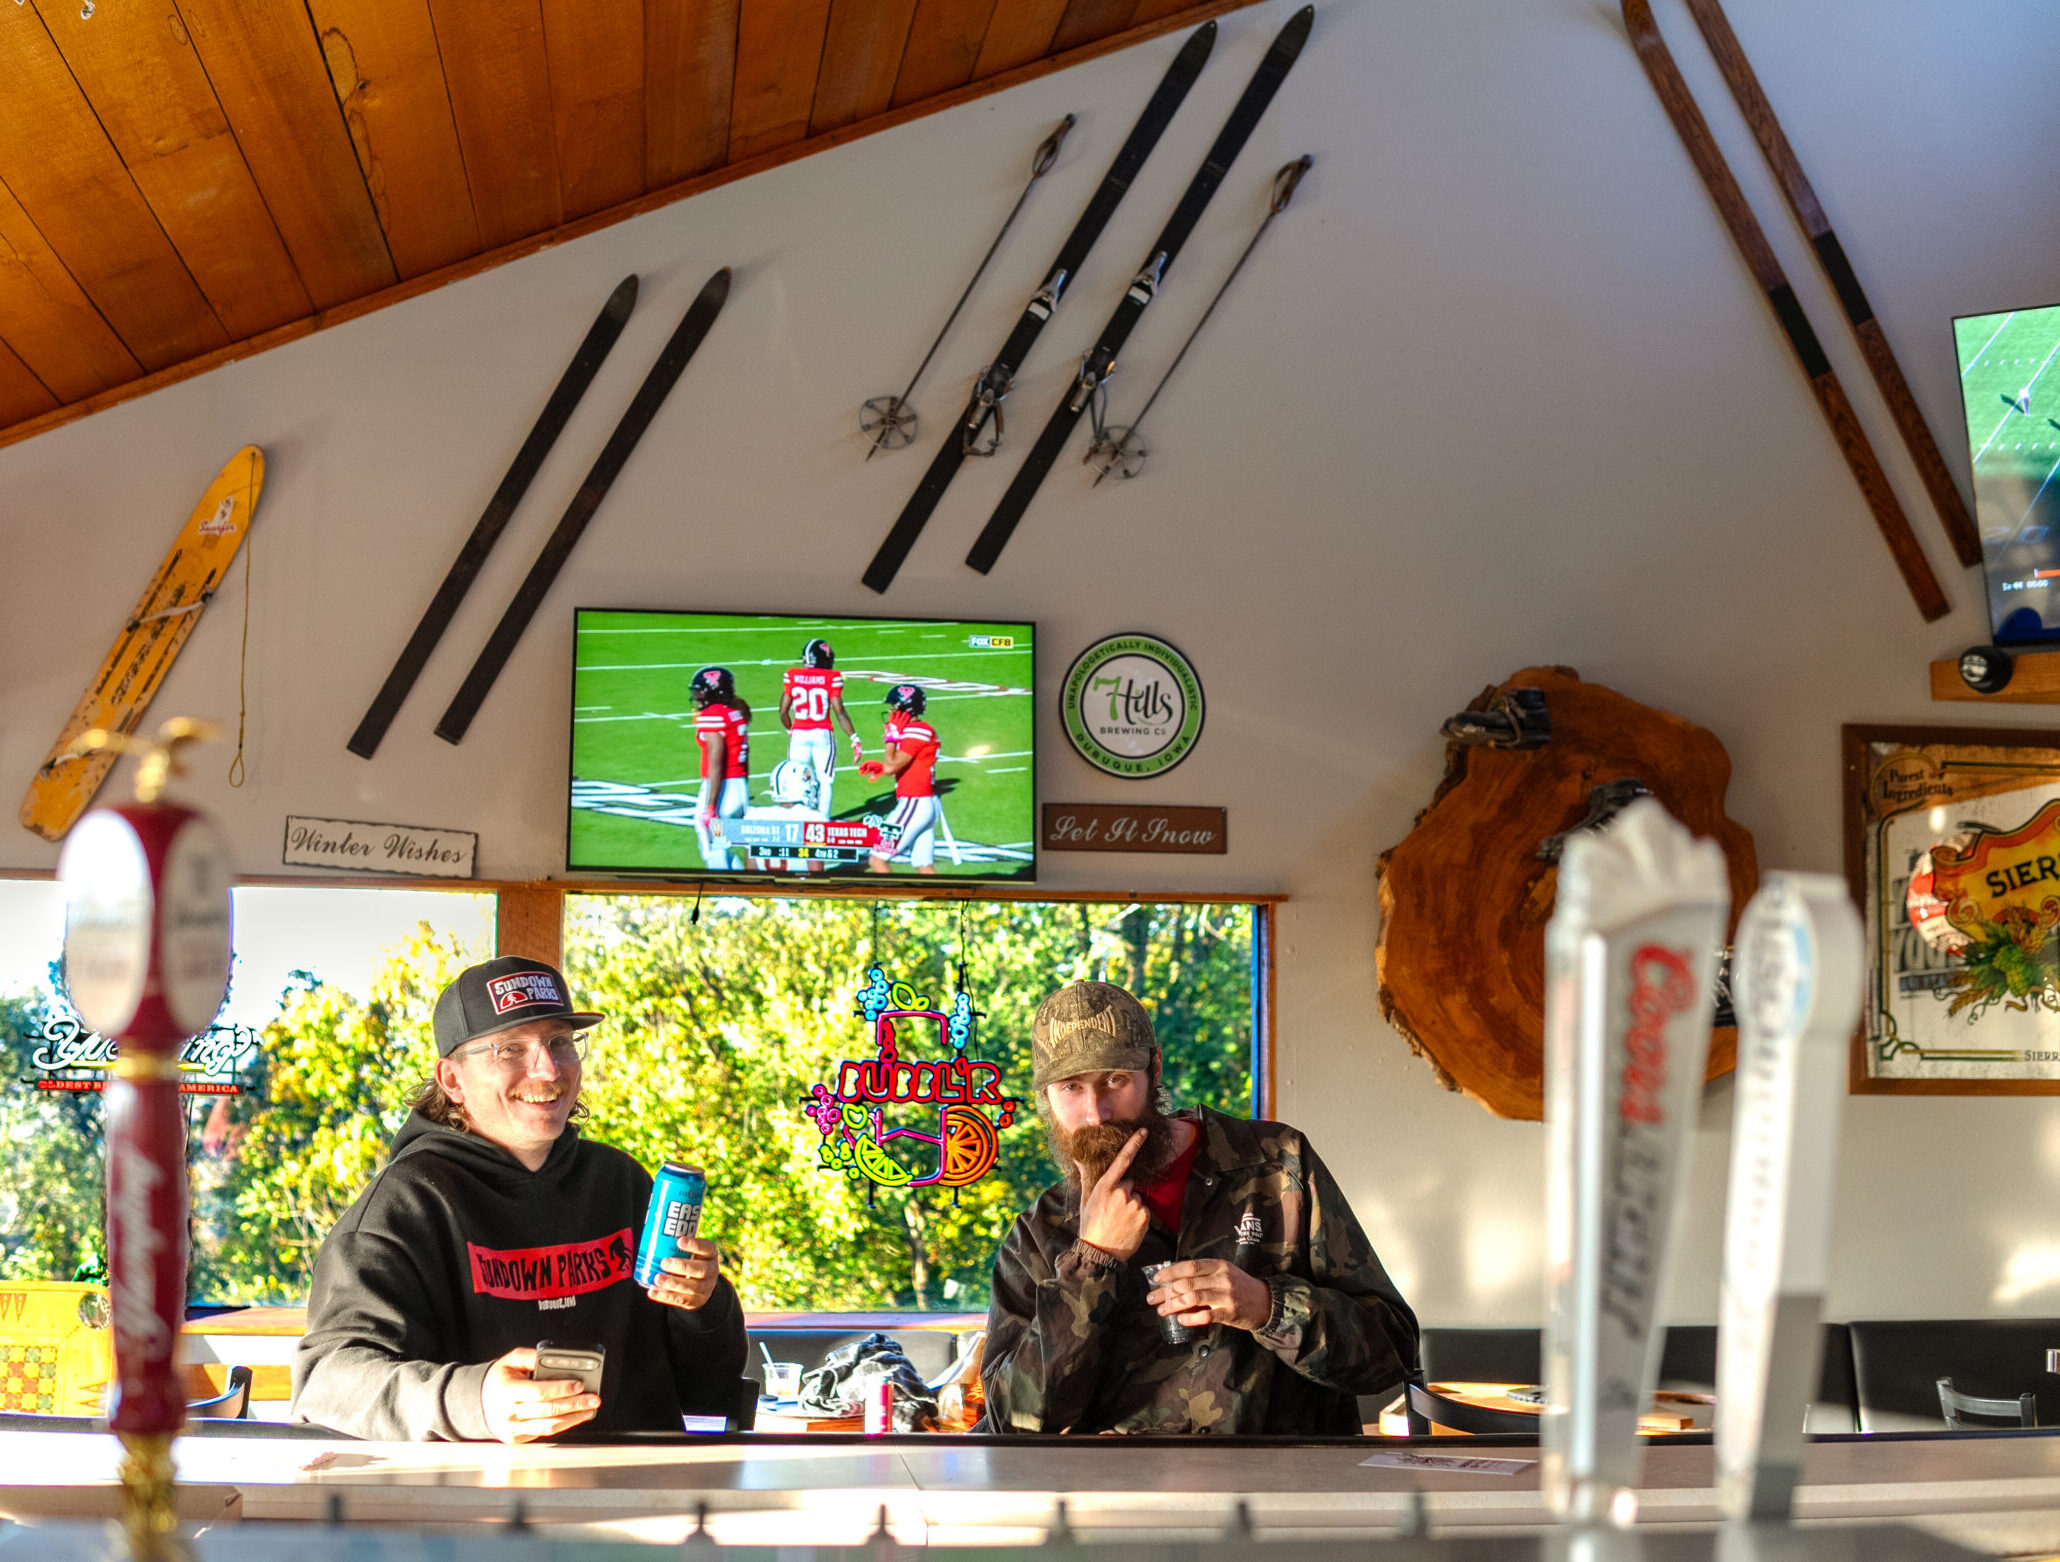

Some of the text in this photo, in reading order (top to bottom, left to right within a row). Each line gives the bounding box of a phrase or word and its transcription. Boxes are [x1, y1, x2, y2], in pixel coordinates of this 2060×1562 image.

[1068, 640, 1198, 711] UNAPOLOGETICALLY INDIVIDUALISTIC
[791, 686, 829, 721] 20
[1092, 676, 1174, 726] 7 Hills
[1100, 726, 1150, 735] BREWING
[1158, 736, 1190, 766] IOWA
[785, 823, 799, 842] 17
[805, 823, 825, 843] 43
[827, 826, 848, 837] TEXAS
[849, 827, 867, 837] TECH
[1050, 815, 1216, 845] Let It Snow
[291, 827, 467, 863] Winter Wishes
[1985, 854, 2060, 898] SIER
[494, 975, 552, 995] SUNDOWN
[527, 987, 559, 1001] PARKS
[37, 1080, 91, 1091] OLDEST
[179, 1083, 239, 1094] AMERICA
[668, 1200, 702, 1222] EAS
[1234, 1220, 1262, 1236] VANS
[476, 1247, 612, 1292] SUNDOWN PARKS
